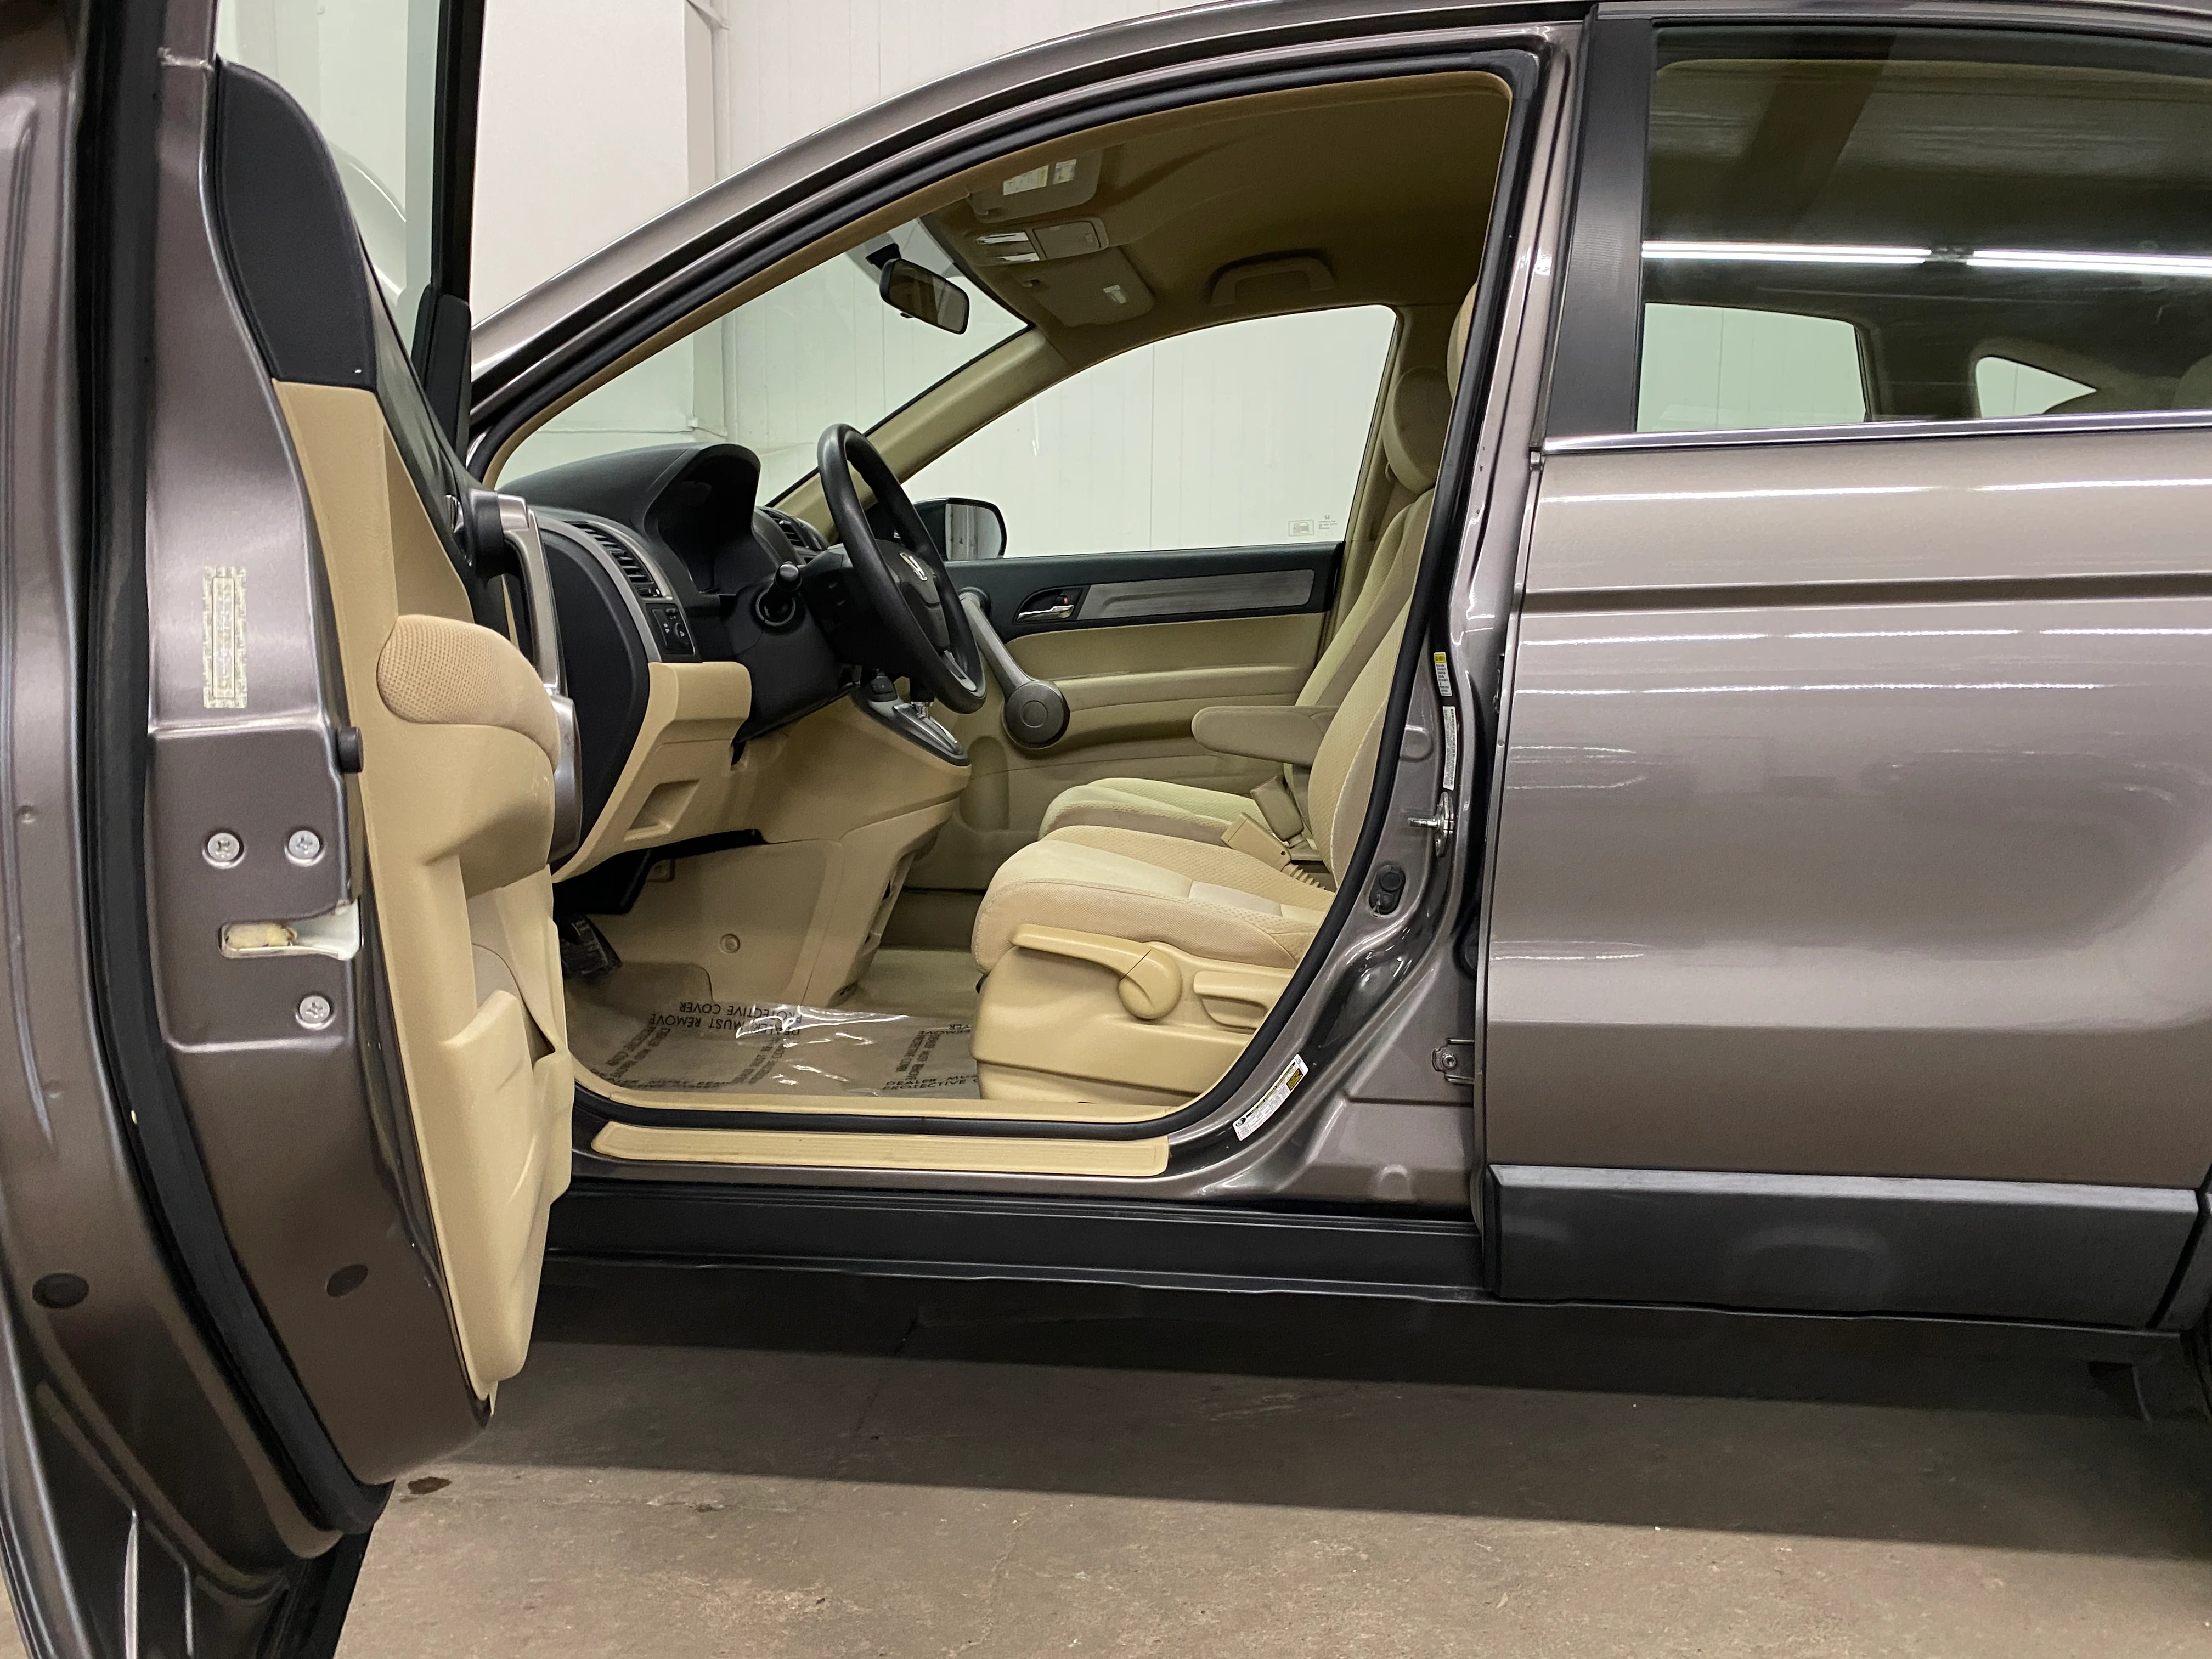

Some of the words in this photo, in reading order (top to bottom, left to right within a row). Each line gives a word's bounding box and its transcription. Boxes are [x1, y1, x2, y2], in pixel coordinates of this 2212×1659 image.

[679, 1002, 721, 1015] COVER
[648, 1013, 701, 1028] REMOVE
[708, 1018, 745, 1031] MUST
[882, 1079, 967, 1090] PROTECTIVE
